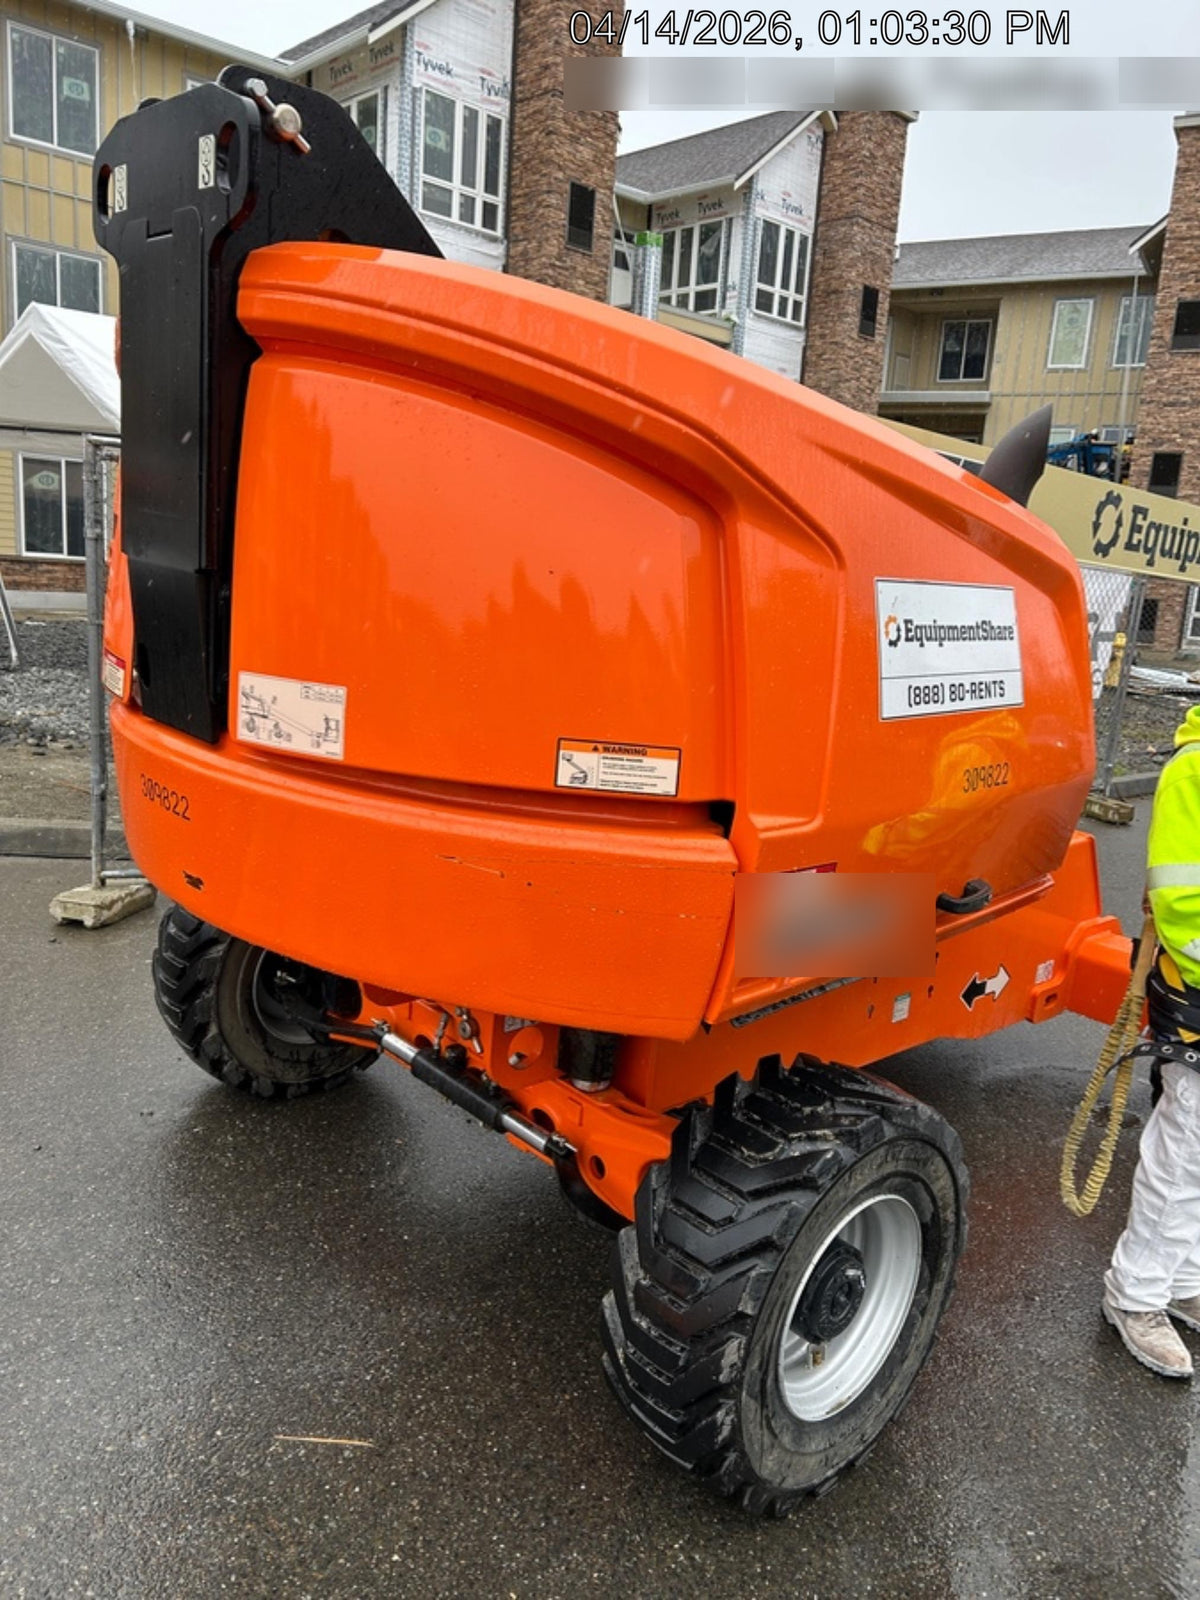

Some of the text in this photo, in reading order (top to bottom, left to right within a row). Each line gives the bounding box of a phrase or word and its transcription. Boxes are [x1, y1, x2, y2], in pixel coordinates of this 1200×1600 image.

[369, 40, 394, 64] Tyvek
[415, 50, 454, 77] Tyvek
[329, 60, 353, 81] Tyvek
[655, 207, 680, 225] Tyvek
[697, 198, 724, 215] Tyvek
[1123, 504, 1200, 573] Equip
[903, 618, 1015, 648] EquipmentShare
[907, 680, 1006, 708] (888) 80-RENTS
[602, 745, 648, 757] WARNING
[963, 762, 1009, 793] 309822
[140, 773, 191, 821] 309822
